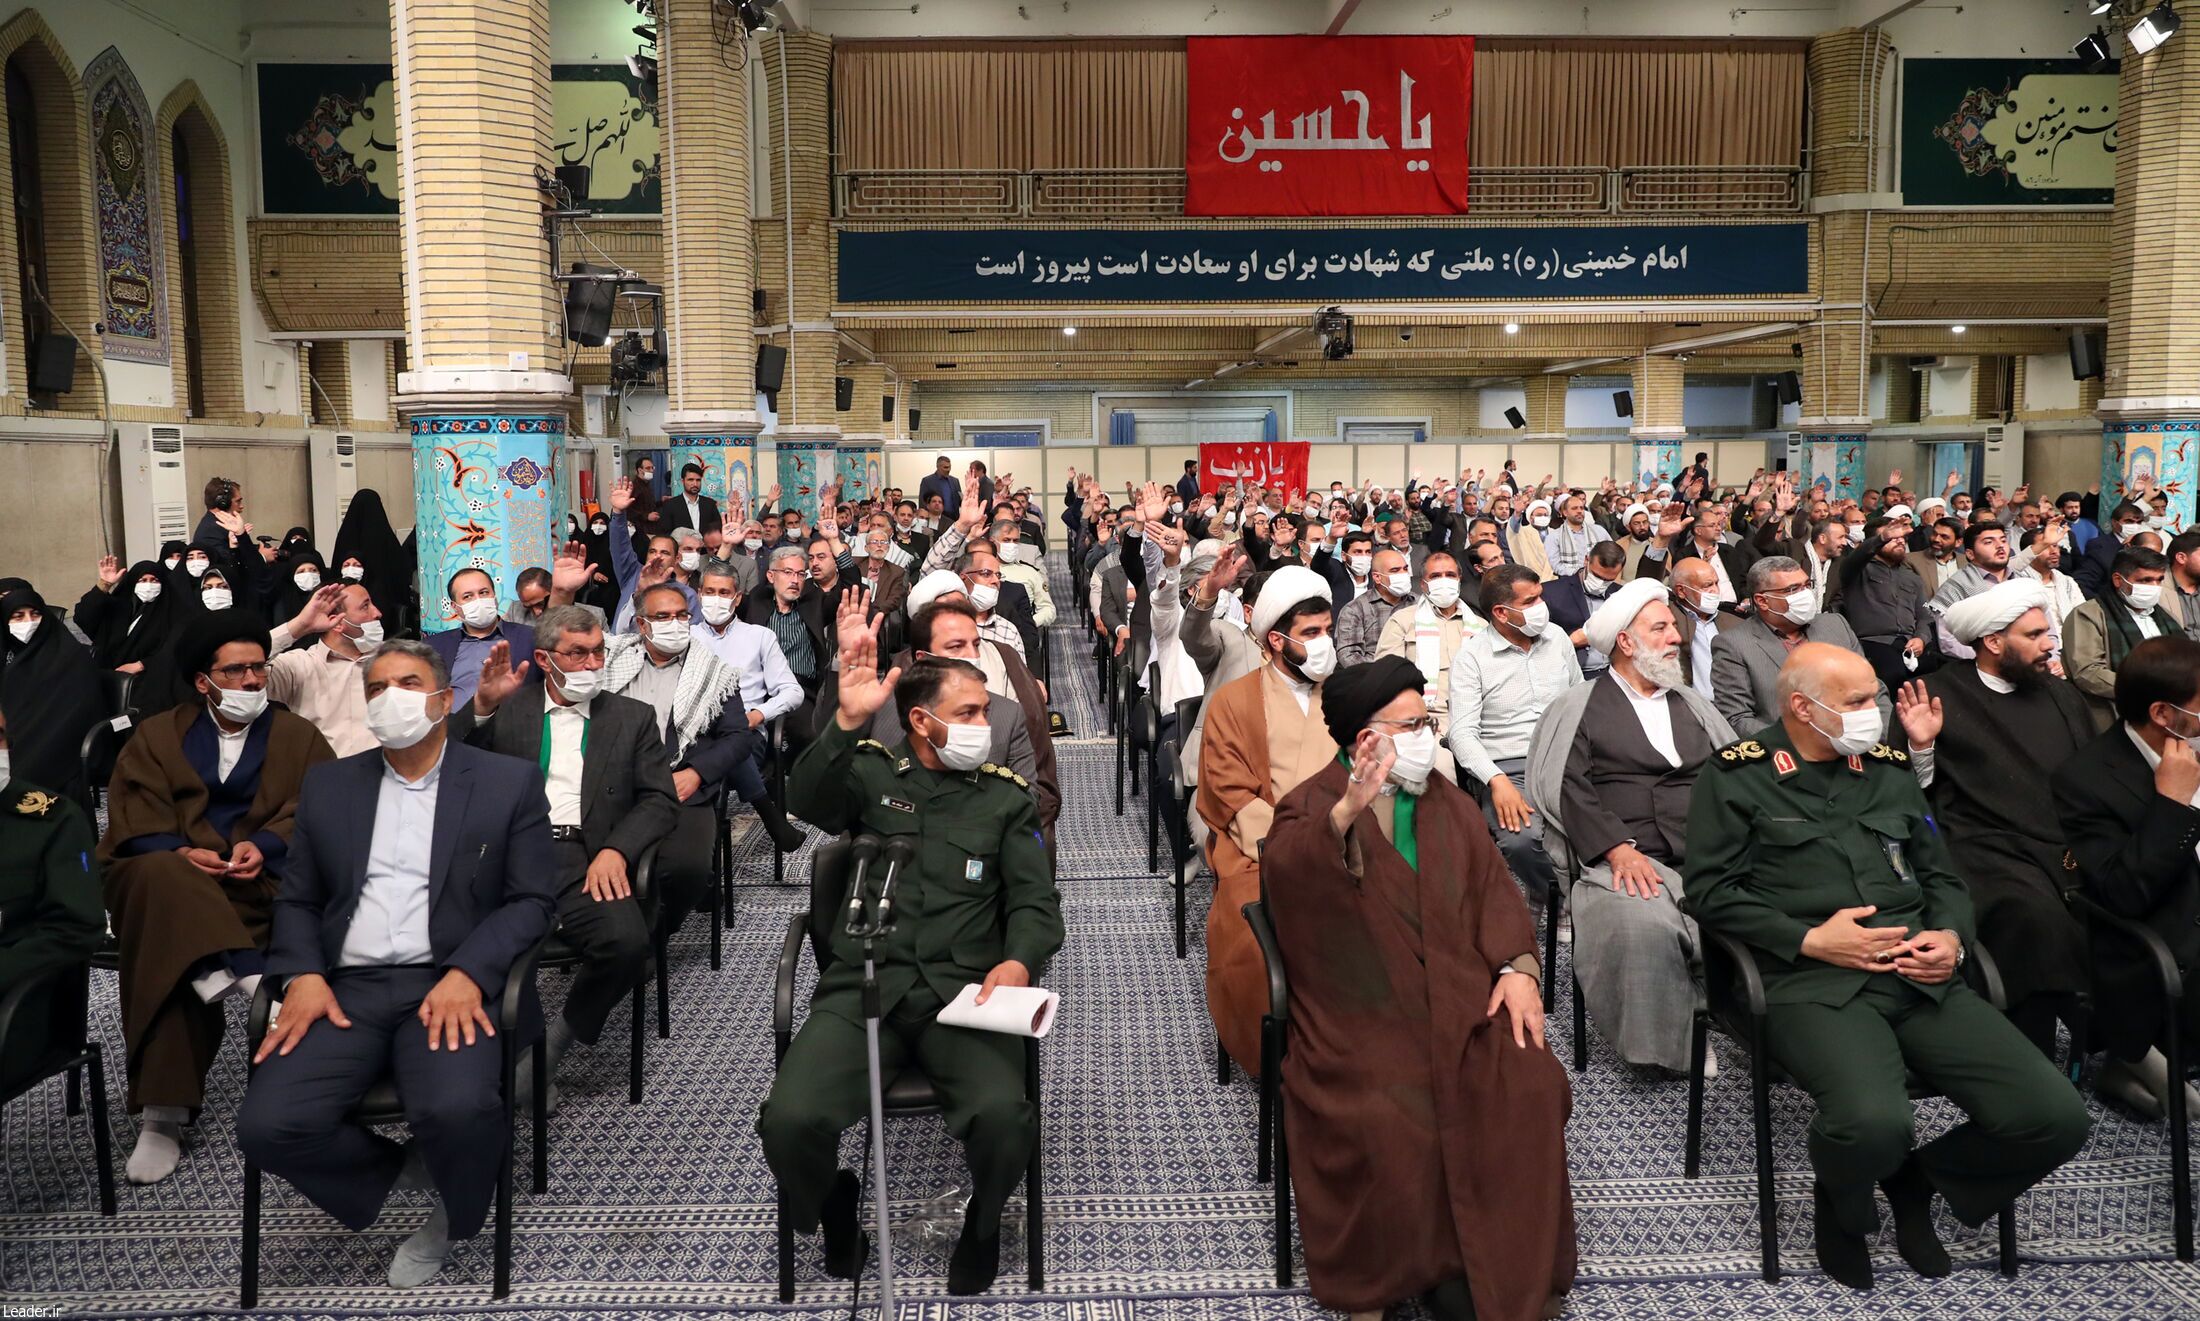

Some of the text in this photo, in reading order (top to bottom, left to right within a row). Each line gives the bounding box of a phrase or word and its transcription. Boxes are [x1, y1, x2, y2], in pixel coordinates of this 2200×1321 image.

[1218, 70, 1432, 172] یا حسین
[975, 250, 1025, 276] است
[1031, 255, 1091, 284] پیروز
[1097, 249, 1148, 276] است
[1155, 249, 1231, 275] سعادت
[1236, 249, 1258, 282] او
[1264, 249, 1318, 281] برای
[1324, 248, 1400, 278] شهادت
[1406, 249, 1435, 273] که
[1440, 247, 1495, 281] ملتی
[1642, 245, 1688, 277] امام
